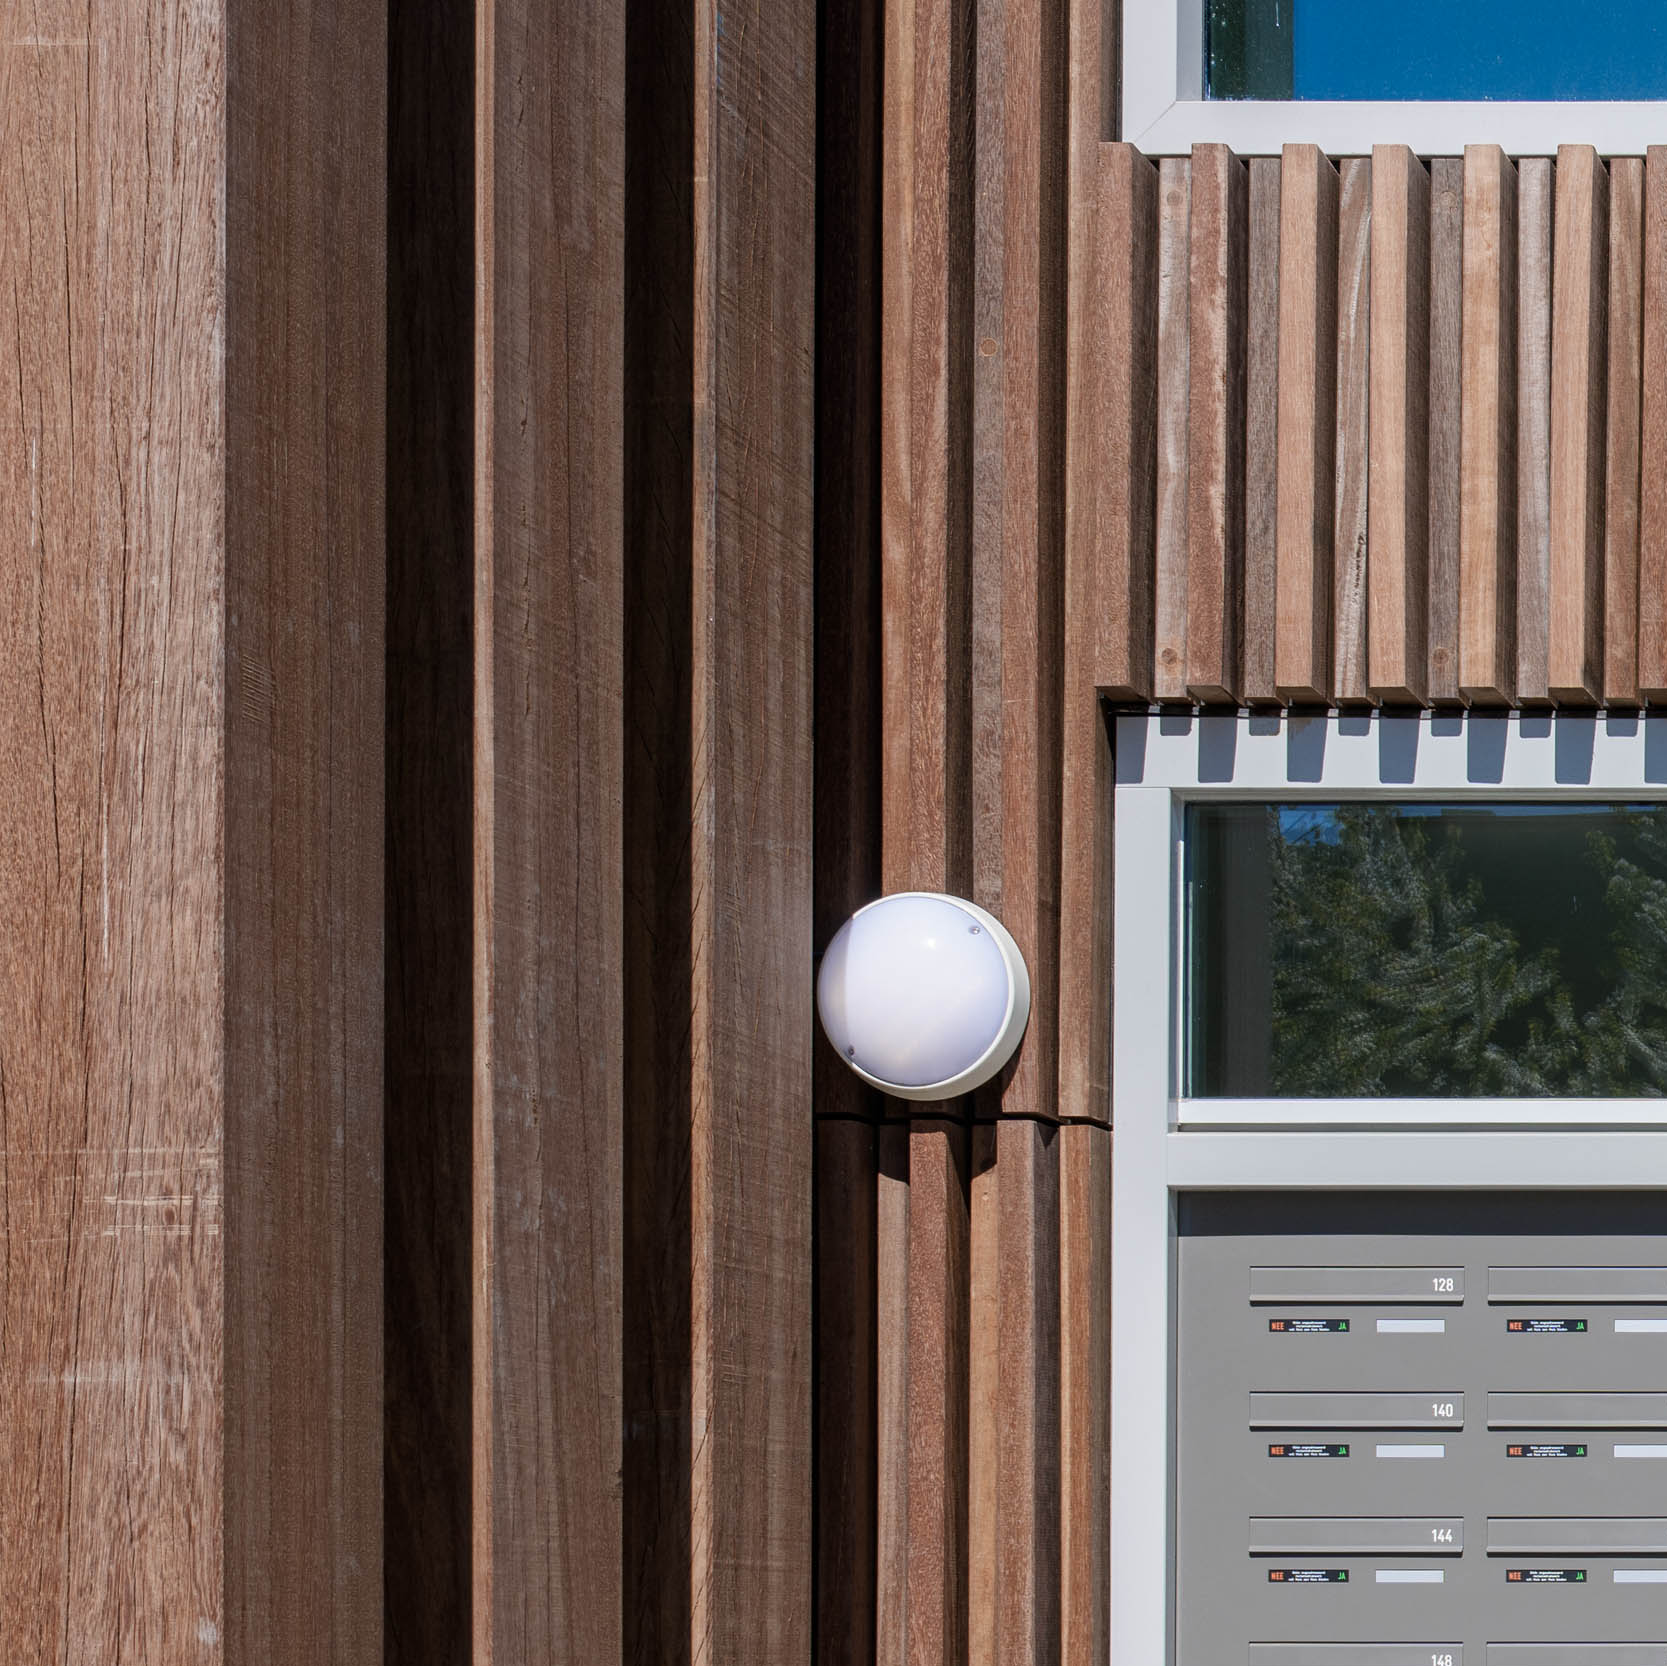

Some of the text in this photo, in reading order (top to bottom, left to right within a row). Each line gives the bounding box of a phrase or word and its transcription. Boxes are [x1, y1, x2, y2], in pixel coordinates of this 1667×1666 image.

[1433, 1278, 1453, 1292] 128
[1272, 1322, 1284, 1330] NEE
[1339, 1322, 1347, 1330] JA
[1509, 1322, 1522, 1330] NEE
[1576, 1322, 1584, 1330] JA
[1432, 1404, 1453, 1417] 140
[1271, 1447, 1284, 1455] NEE
[1339, 1447, 1347, 1455] JA
[1509, 1448, 1521, 1456] NEE
[1576, 1448, 1584, 1456] JA
[1432, 1529, 1452, 1542] 144
[1271, 1572, 1283, 1580] NEE
[1338, 1572, 1346, 1580] JA
[1509, 1572, 1521, 1580] NEE
[1576, 1572, 1584, 1580] JA
